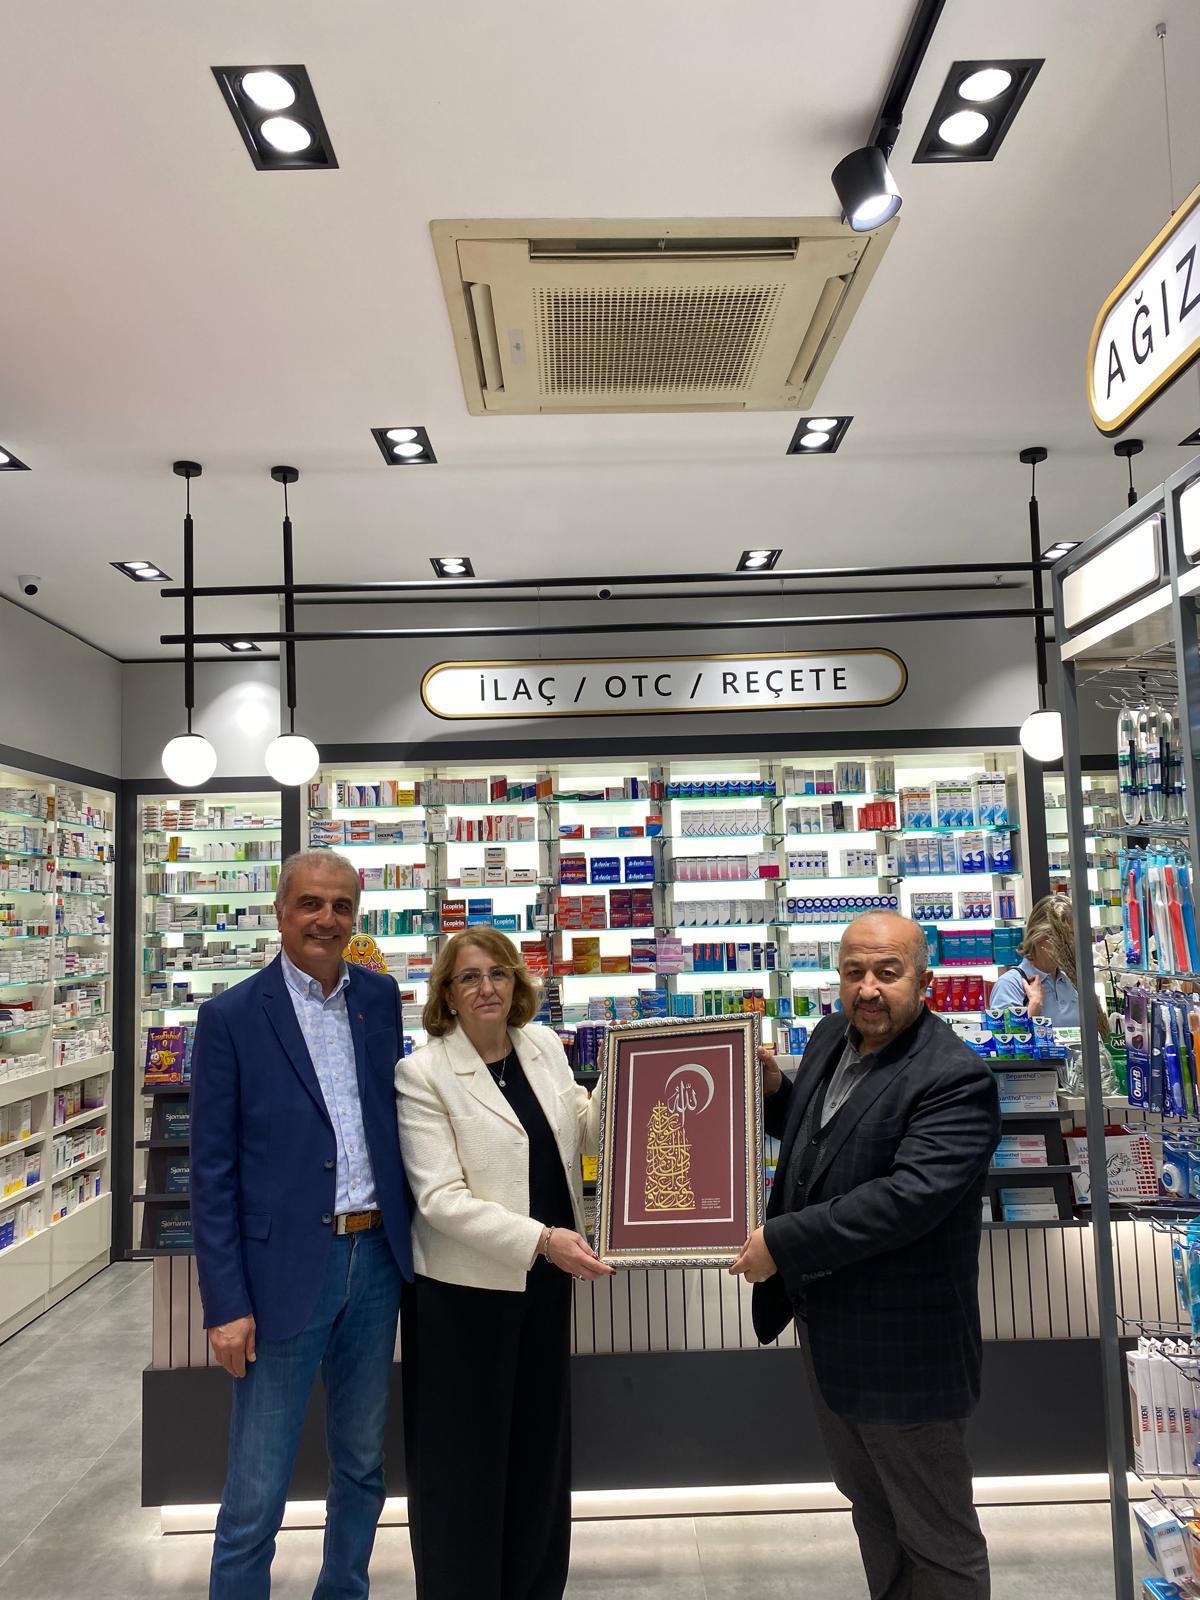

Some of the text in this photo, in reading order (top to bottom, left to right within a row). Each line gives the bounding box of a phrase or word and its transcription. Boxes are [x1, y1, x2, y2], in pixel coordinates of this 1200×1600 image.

[479, 673, 557, 705] İLAÇ
[604, 673, 674, 700] OTC
[722, 667, 849, 699] REÇETE
[443, 903, 464, 911] Ecopirin
[443, 920, 465, 928] Ecopirin
[493, 918, 515, 927] Ecopirin
[1132, 1069, 1142, 1098] Oral-B
